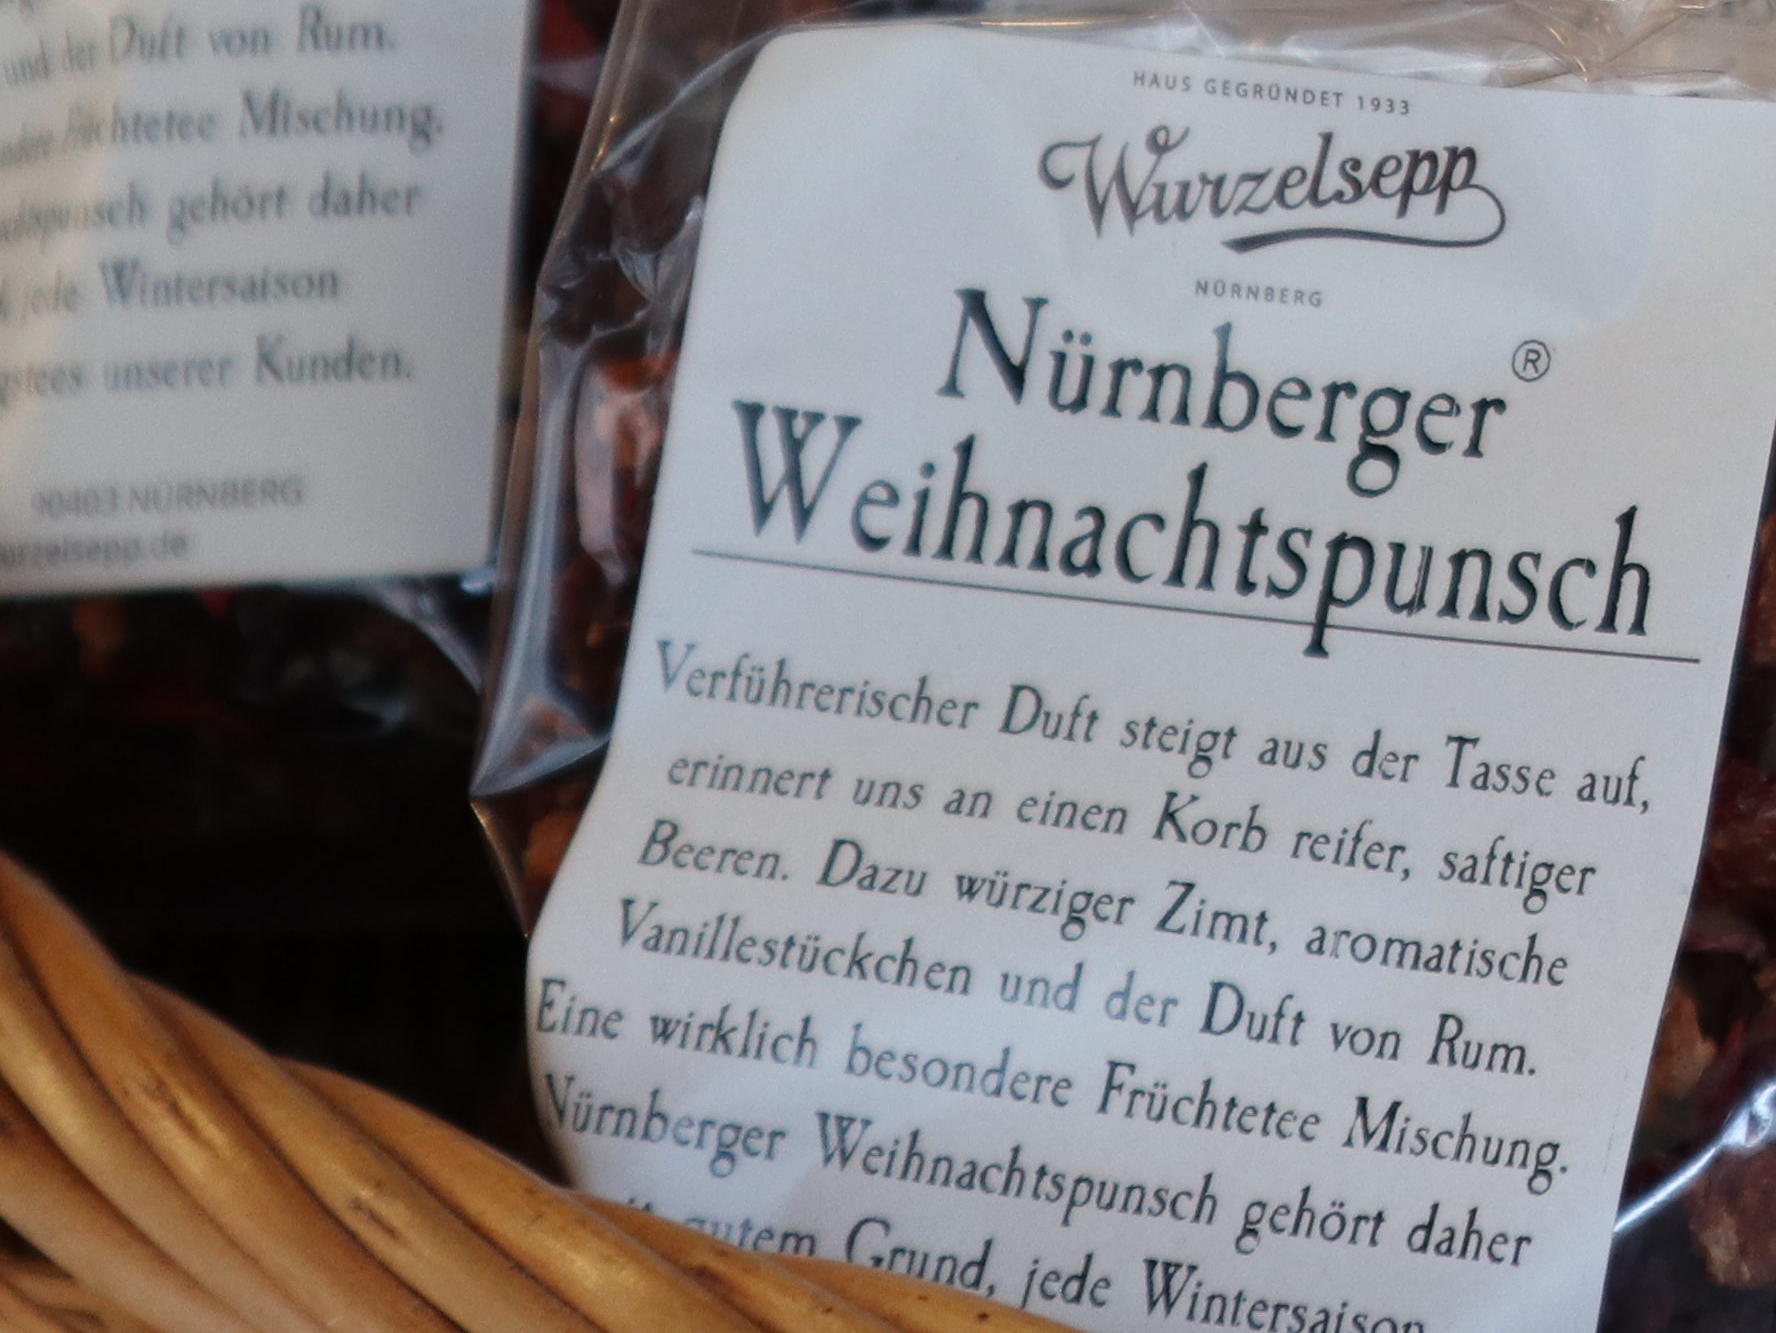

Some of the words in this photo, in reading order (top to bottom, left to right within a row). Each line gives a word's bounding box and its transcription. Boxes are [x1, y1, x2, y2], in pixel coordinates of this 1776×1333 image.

[1133, 71, 1191, 93] HAUS
[1205, 78, 1343, 109] GEGRÜNDET
[1358, 94, 1411, 116] 1933
[308, 169, 422, 219] daher
[1037, 124, 1506, 253] Wurzelsepp
[1195, 279, 1322, 308] NÜRNBERG
[937, 287, 1507, 498] Nürnberger
[732, 398, 1653, 659] Weihnachtspunsch
[655, 638, 980, 731] Verführerischer
[998, 683, 1099, 744] Duft
[1120, 712, 1238, 780] steigt
[1258, 734, 1328, 772] aus
[1351, 729, 1420, 785] der
[1443, 734, 1556, 798] Tasse
[1576, 754, 1651, 815] auf,
[637, 818, 790, 882] Beeren.
[816, 837, 926, 897] Dazu
[955, 870, 1136, 942] würziger
[1156, 878, 1278, 956] Zimt,
[1304, 923, 1569, 989] aromatische
[668, 752, 833, 801] erinnert
[852, 774, 923, 812] uns
[943, 787, 991, 820] an
[1015, 792, 1128, 838] einen
[1152, 790, 1268, 854] Korb
[1290, 818, 1411, 882] reifer,
[1437, 835, 1597, 915] saftiger
[618, 896, 972, 997] Vanillestückchen
[999, 961, 1083, 1015] und
[1104, 968, 1178, 1029] der
[1199, 981, 1307, 1050] Duft
[1330, 1021, 1401, 1062] von
[1427, 1012, 1538, 1078] Rum.
[536, 976, 624, 1041] Eine
[650, 1002, 818, 1070] wirklich
[843, 1022, 1073, 1109] besondere
[1098, 1058, 1321, 1144] Früchtetee
[1342, 1095, 1570, 1196] Mischung.
[545, 1073, 788, 1179] Nürnberger
[816, 1110, 1219, 1229] Weihnachtspunsch
[1234, 1185, 1388, 1255] gehört
[1406, 1201, 1534, 1269] daher
[844, 1215, 998, 1299] Grund,
[1021, 1251, 1112, 1314] jede
